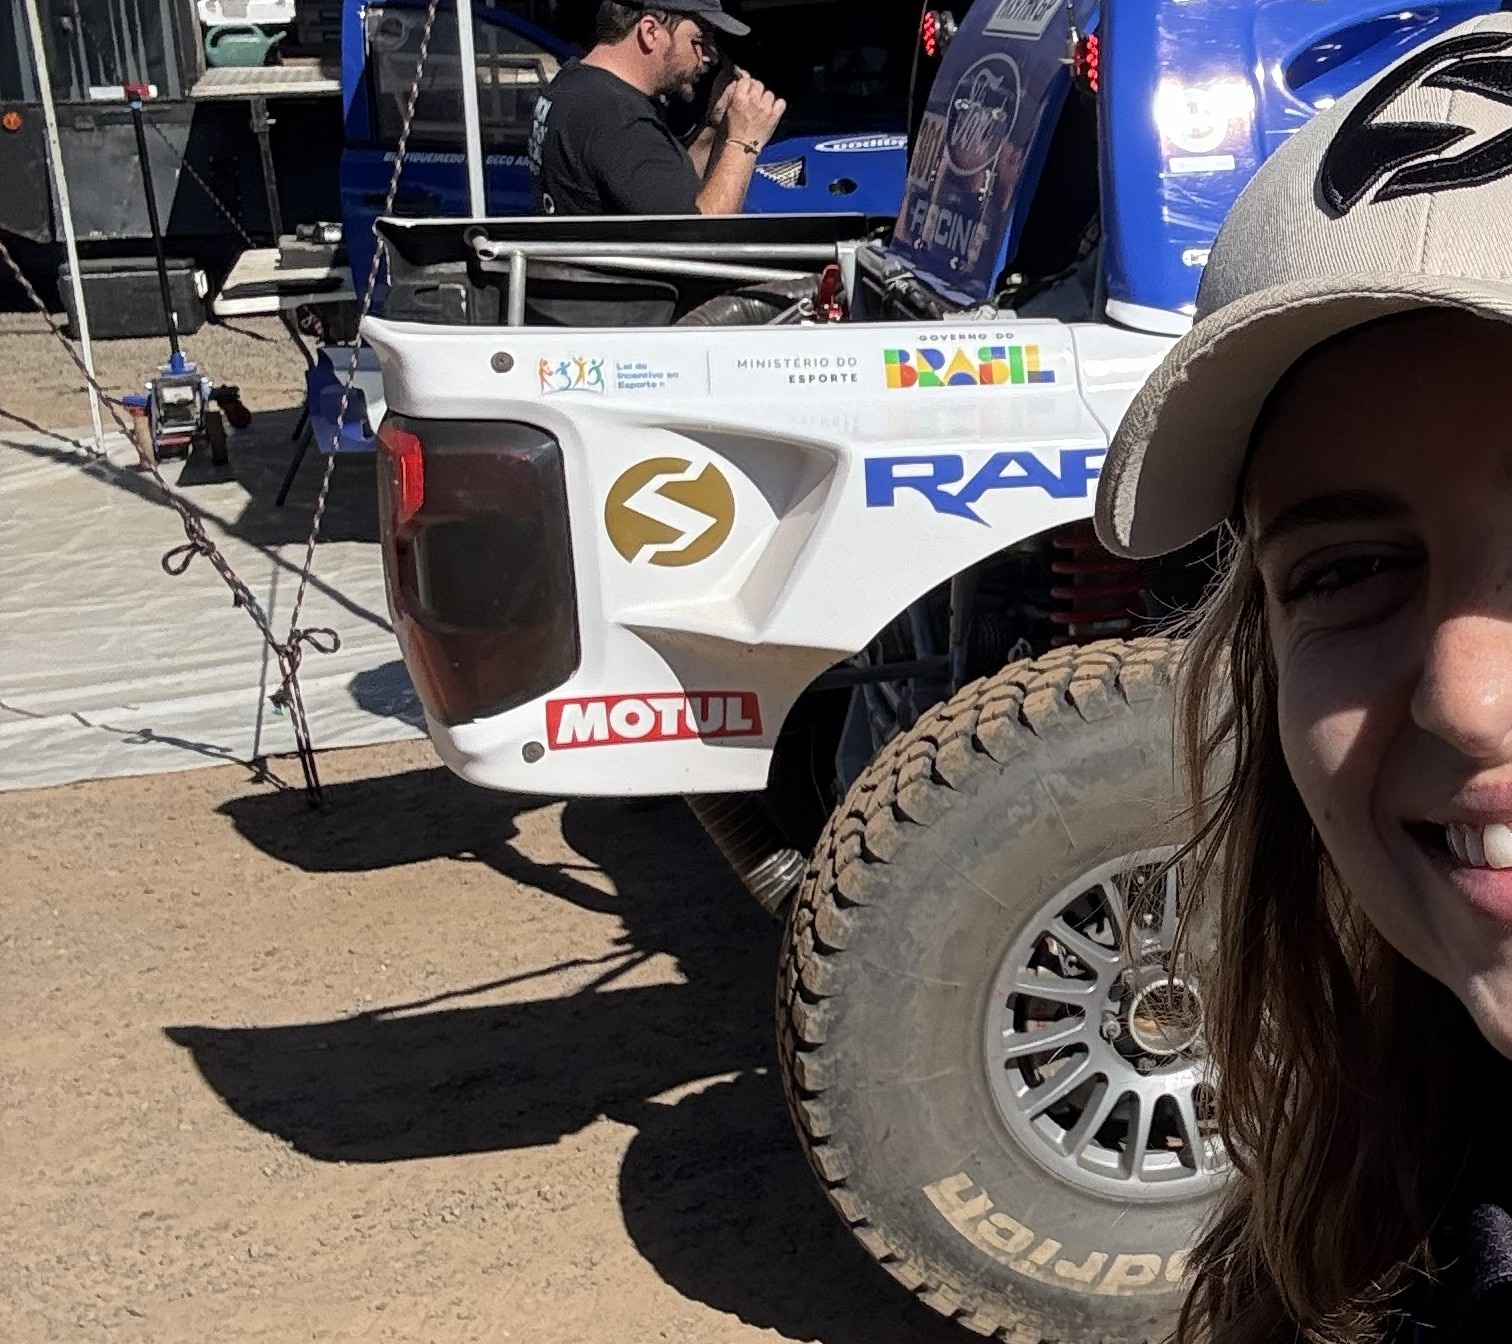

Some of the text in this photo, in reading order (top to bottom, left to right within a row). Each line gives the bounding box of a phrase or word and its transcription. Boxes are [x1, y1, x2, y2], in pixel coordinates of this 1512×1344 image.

[919, 332, 1015, 342] GOVERNO DO
[737, 356, 858, 370] MINISTÉRIO DO
[884, 344, 1056, 390] BRASIL
[788, 372, 858, 384] ESPORTE
[556, 694, 754, 745] MOTUL
